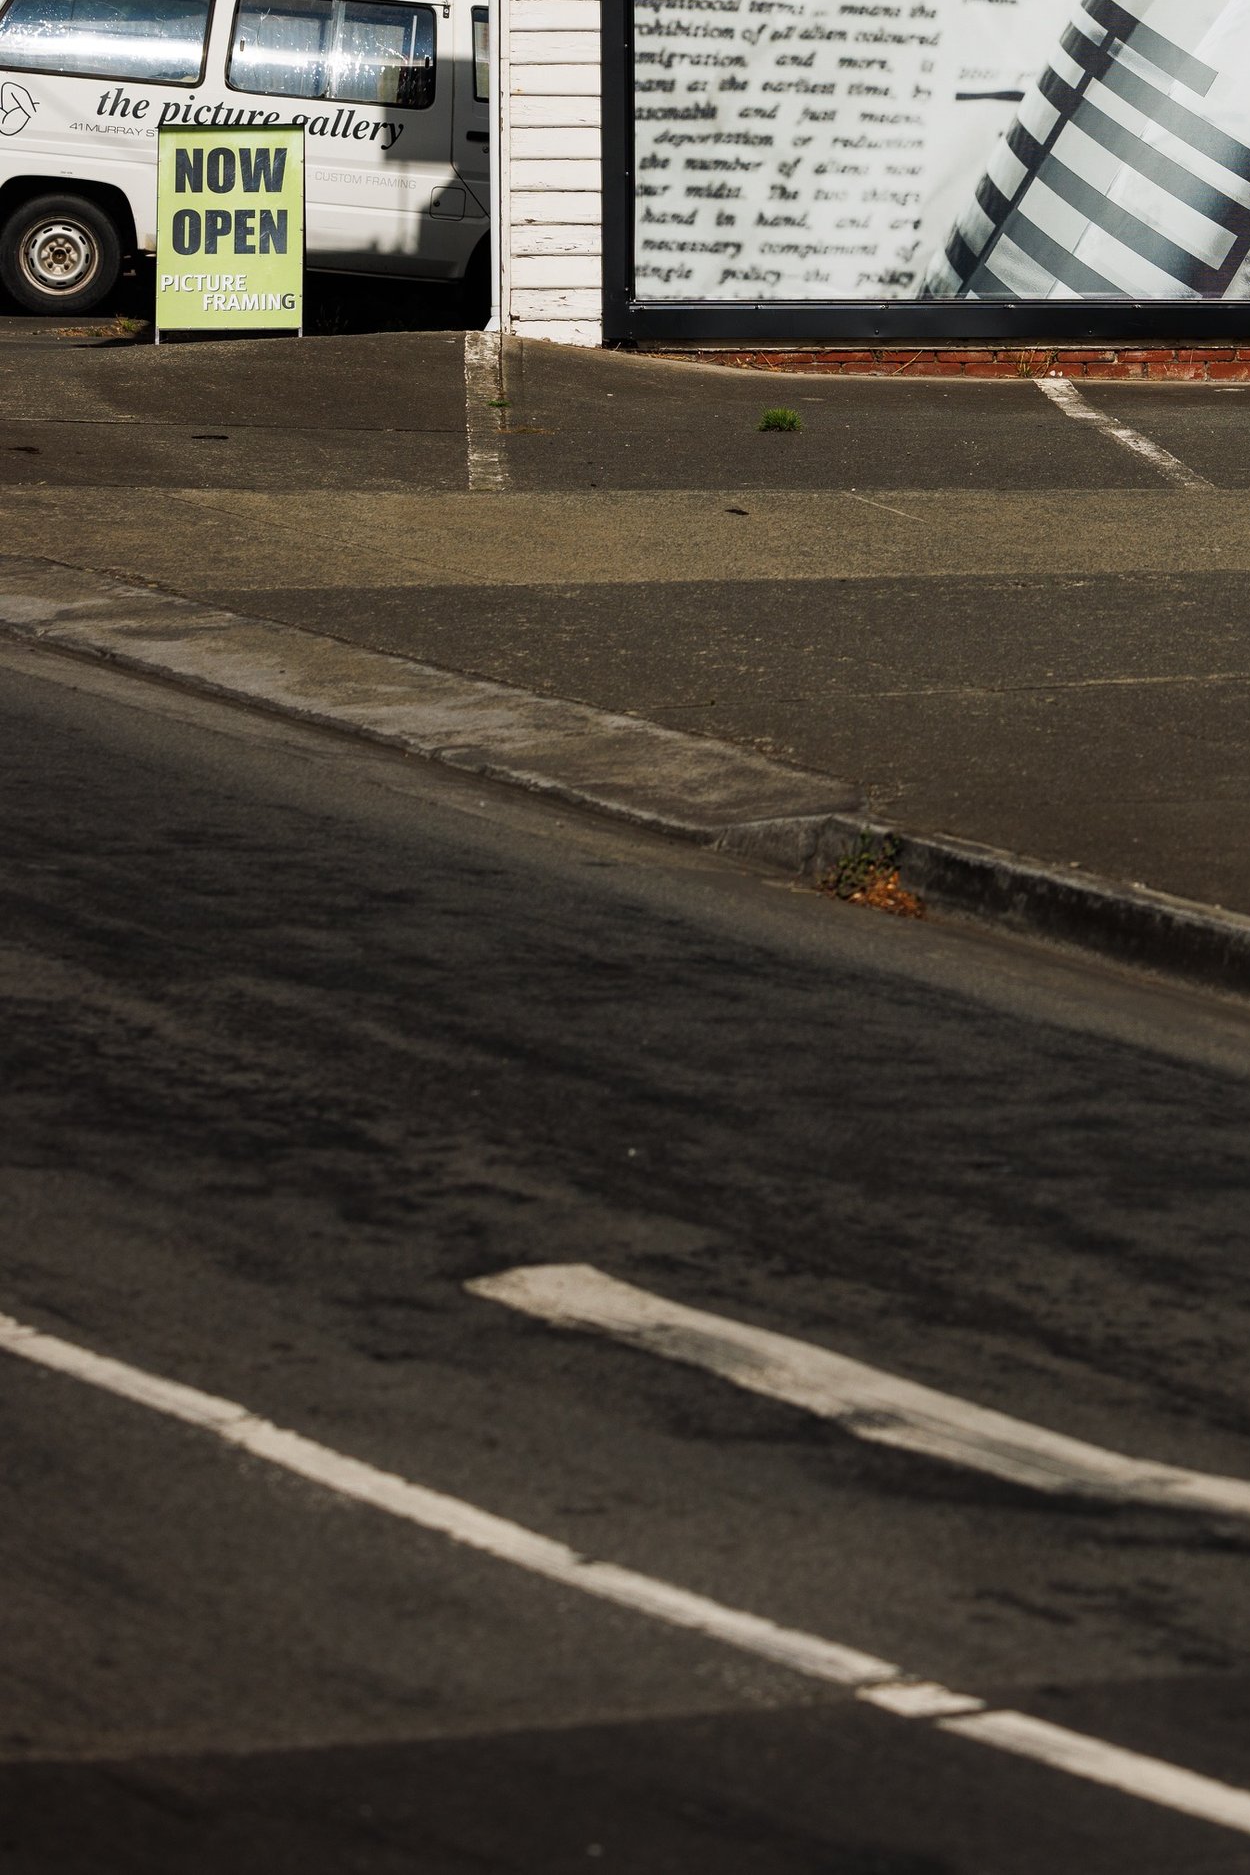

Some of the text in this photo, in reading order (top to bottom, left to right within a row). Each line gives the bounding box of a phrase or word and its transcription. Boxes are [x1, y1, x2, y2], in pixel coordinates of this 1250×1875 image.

[741, 23, 768, 46] of
[774, 50, 818, 69] and
[95, 87, 150, 120] the
[157, 94, 281, 127] picture
[86, 123, 144, 136] MURRAY
[145, 128, 158, 138] S
[652, 128, 776, 148] deportation
[174, 146, 288, 194] NOW
[638, 151, 672, 172] the
[683, 157, 764, 174] number
[314, 170, 417, 190] CUSTOM FRAMING
[639, 206, 698, 227] hand
[172, 208, 288, 256] OPEN
[640, 237, 744, 260] necessary
[160, 274, 248, 292] PICTURE
[202, 293, 296, 312] FRAMING
